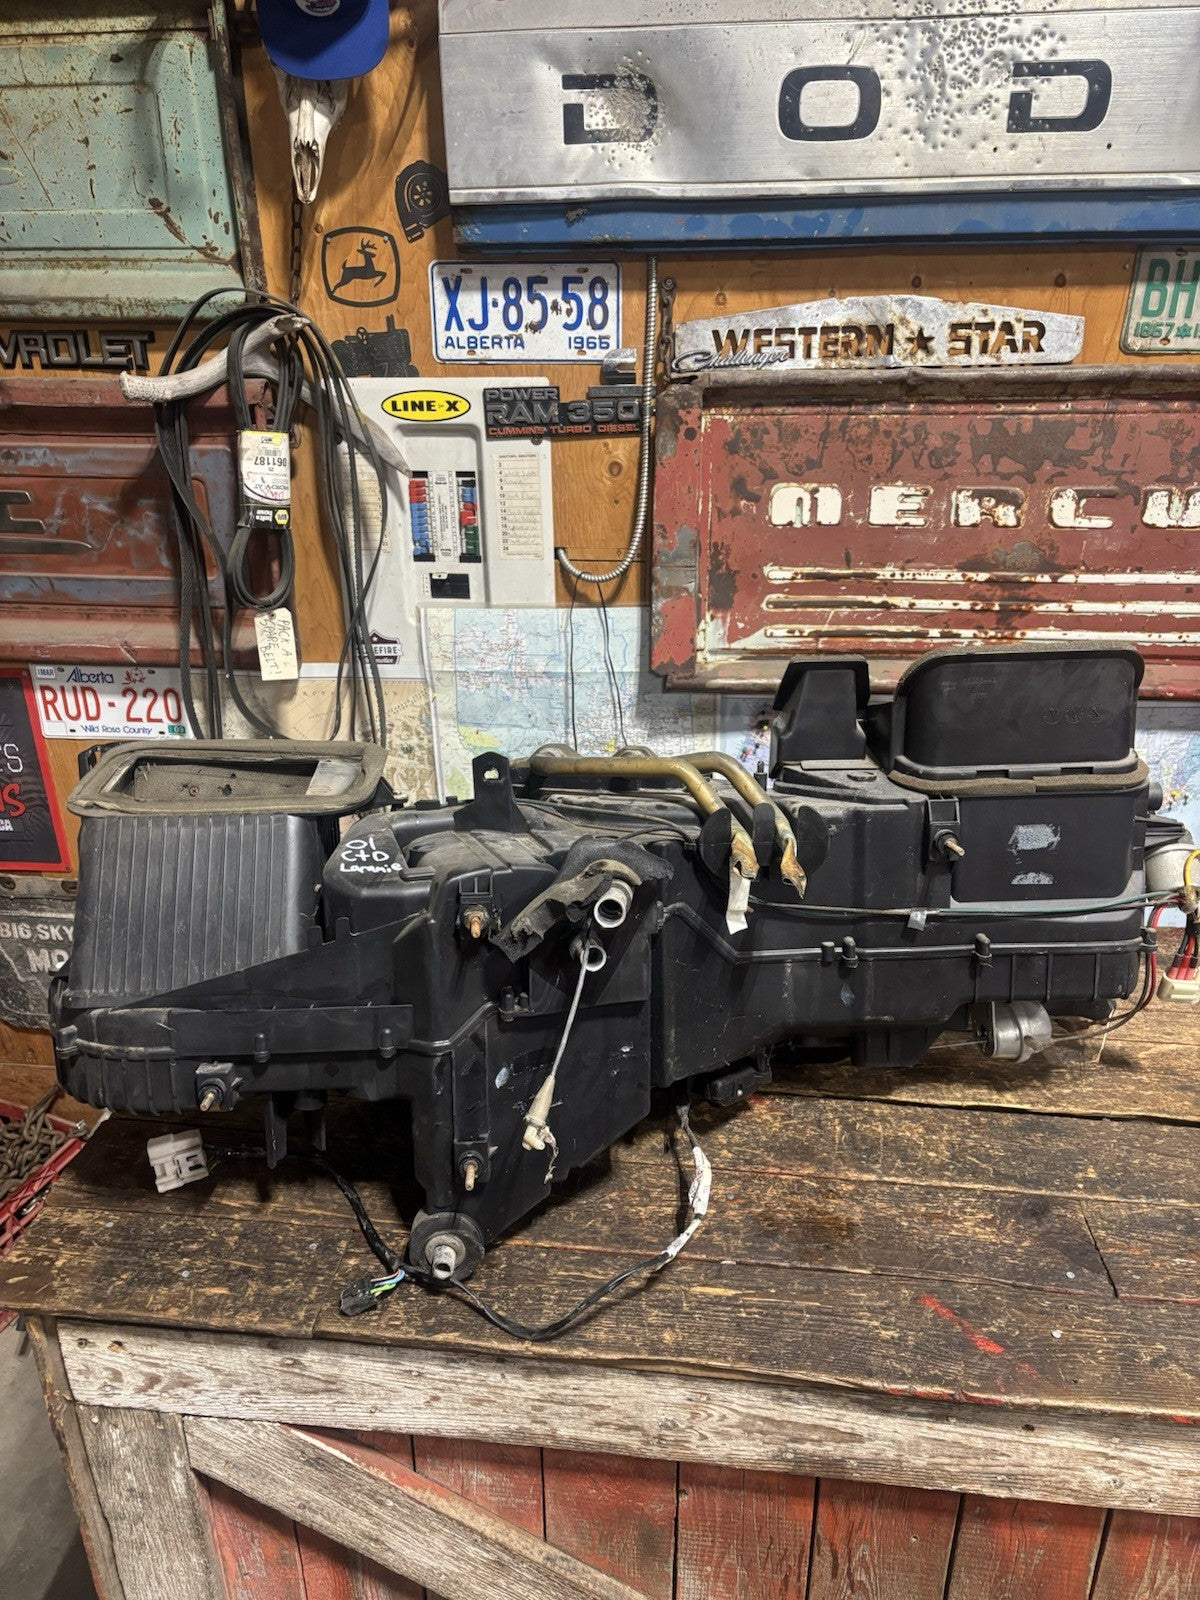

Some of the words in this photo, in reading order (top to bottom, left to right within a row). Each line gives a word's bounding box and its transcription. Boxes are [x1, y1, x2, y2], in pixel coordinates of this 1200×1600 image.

[1141, 258, 1200, 318] BH
[444, 335, 525, 350] ALBERTA
[711, 322, 895, 359] WESTERN
[947, 320, 1046, 355] STAR
[671, 349, 789, 371] Challenger
[485, 387, 559, 400] POWER
[486, 402, 559, 424] RAM
[568, 399, 640, 422] 350
[488, 426, 545, 436] CUMMINS
[551, 425, 591, 433] TURBO
[597, 423, 640, 433] DIESEL
[254, 456, 287, 466] 061187
[768, 482, 1200, 530] MERCU
[259, 619, 279, 648] SPARE
[277, 620, 291, 644] PACK
[373, 646, 398, 655] EFIRE
[66, 666, 115, 684] Alberta
[81, 724, 99, 733] Wild
[101, 725, 120, 734] Rose
[123, 725, 153, 736] Country
[0, 922, 32, 939] BIG
[36, 923, 75, 941] SKY
